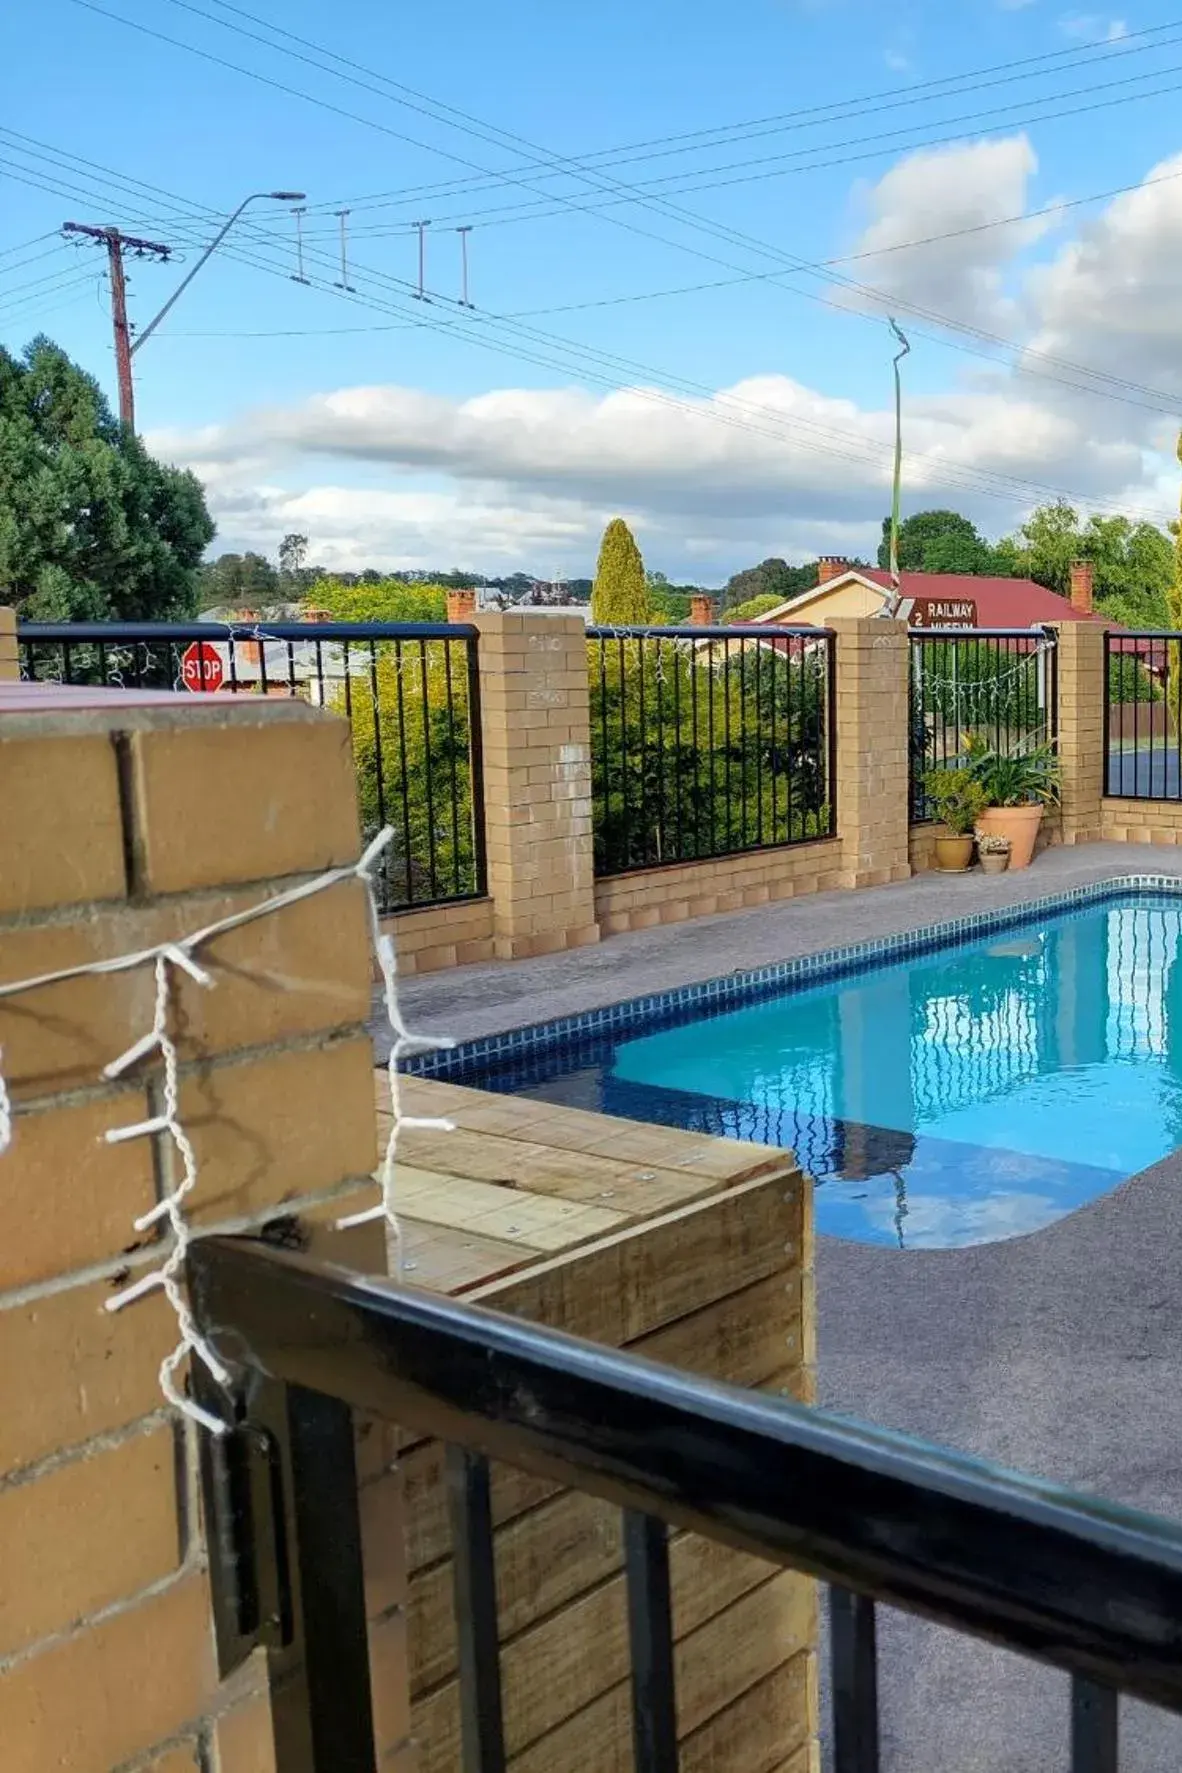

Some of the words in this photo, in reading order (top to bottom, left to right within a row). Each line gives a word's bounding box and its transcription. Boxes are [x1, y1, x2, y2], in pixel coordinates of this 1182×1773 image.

[928, 603, 973, 618] RAILWAY
[915, 612, 923, 626] 2
[187, 660, 220, 680] STOP
